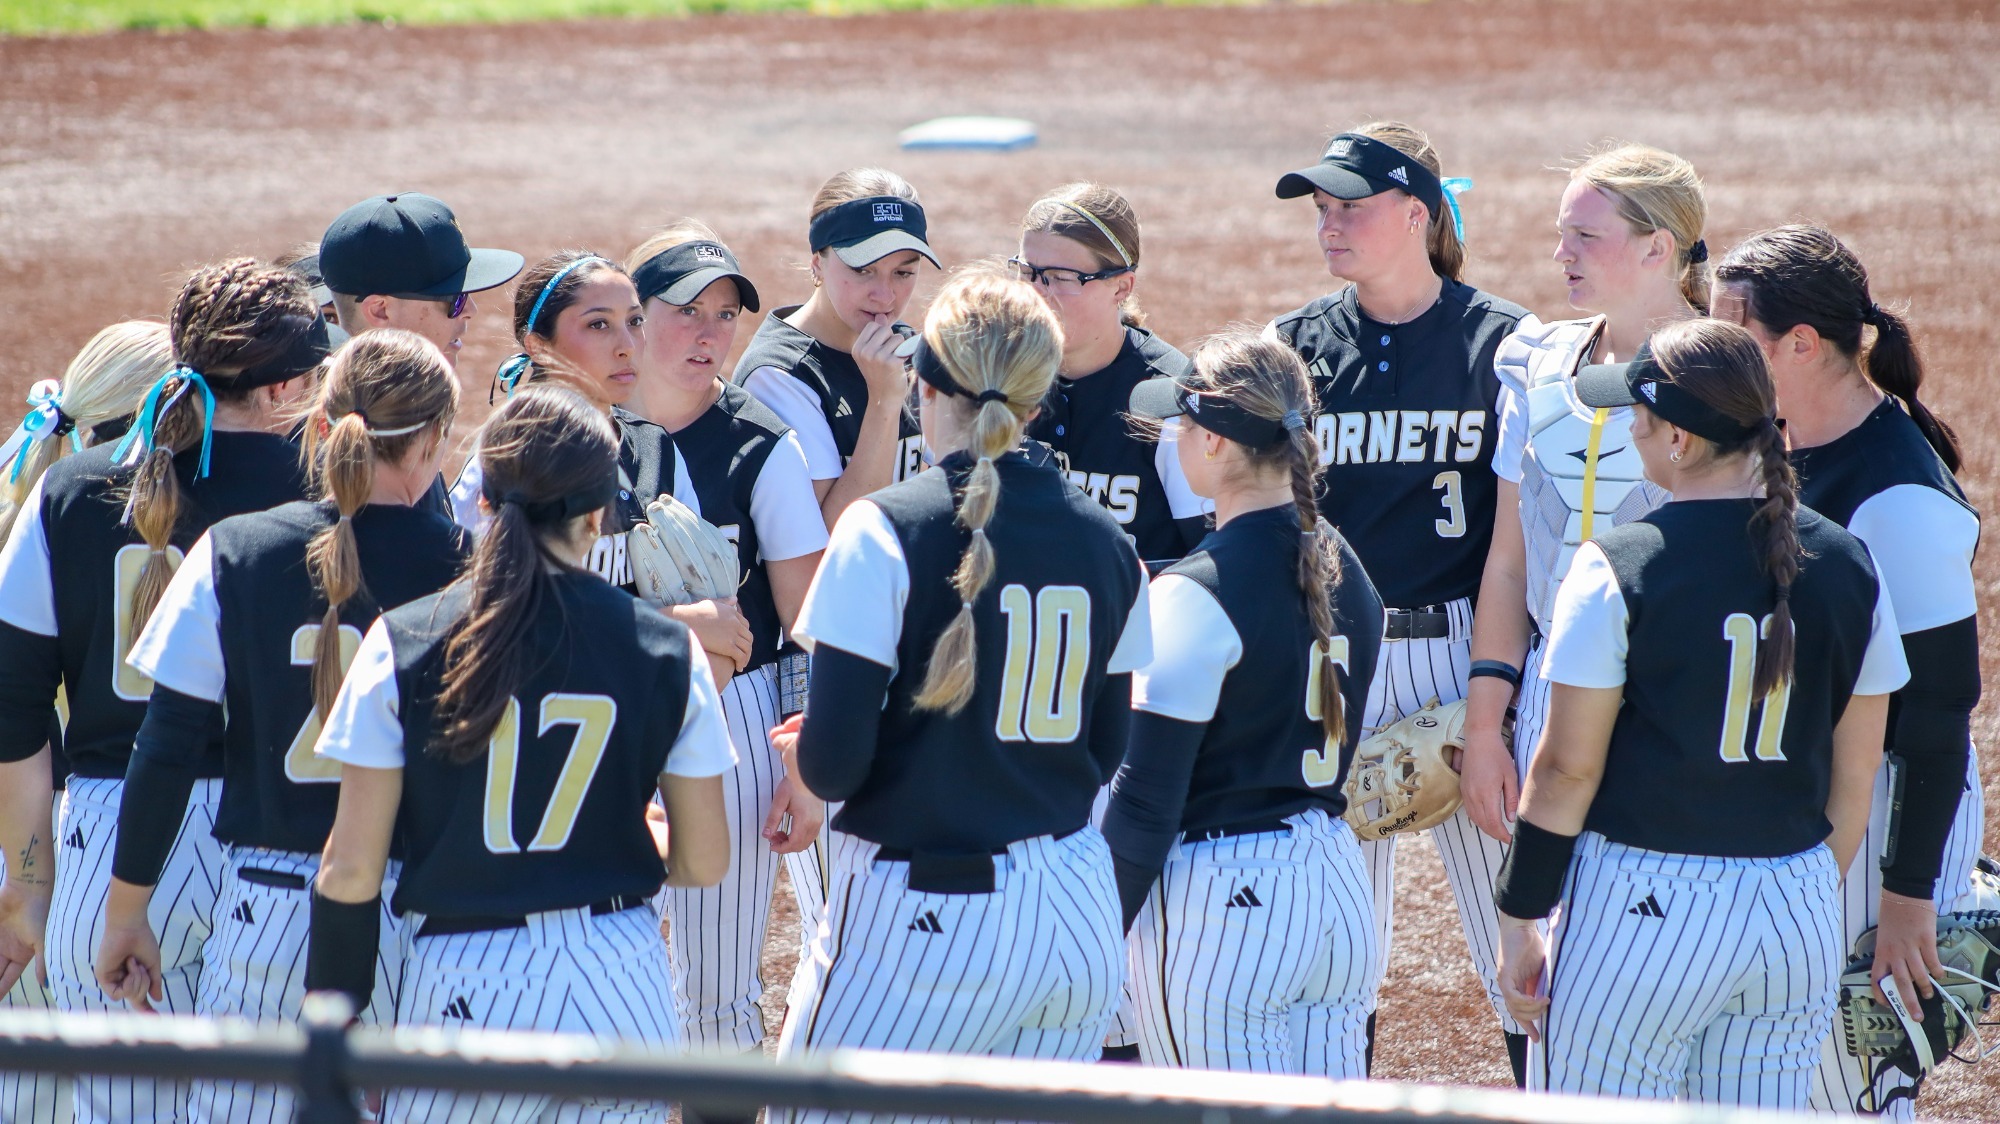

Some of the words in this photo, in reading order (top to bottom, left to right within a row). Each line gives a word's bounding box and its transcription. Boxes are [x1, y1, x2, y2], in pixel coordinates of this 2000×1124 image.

[872, 203, 902, 217] ESU
[694, 246, 724, 259] ESU
[1312, 410, 1486, 467] ORNETS
[1432, 470, 1467, 538] 3
[995, 583, 1092, 743] 10
[1719, 613, 1796, 763] 11
[1302, 635, 1350, 788] 5
[483, 692, 617, 854] 17
[1378, 809, 1418, 836] Rawlings
